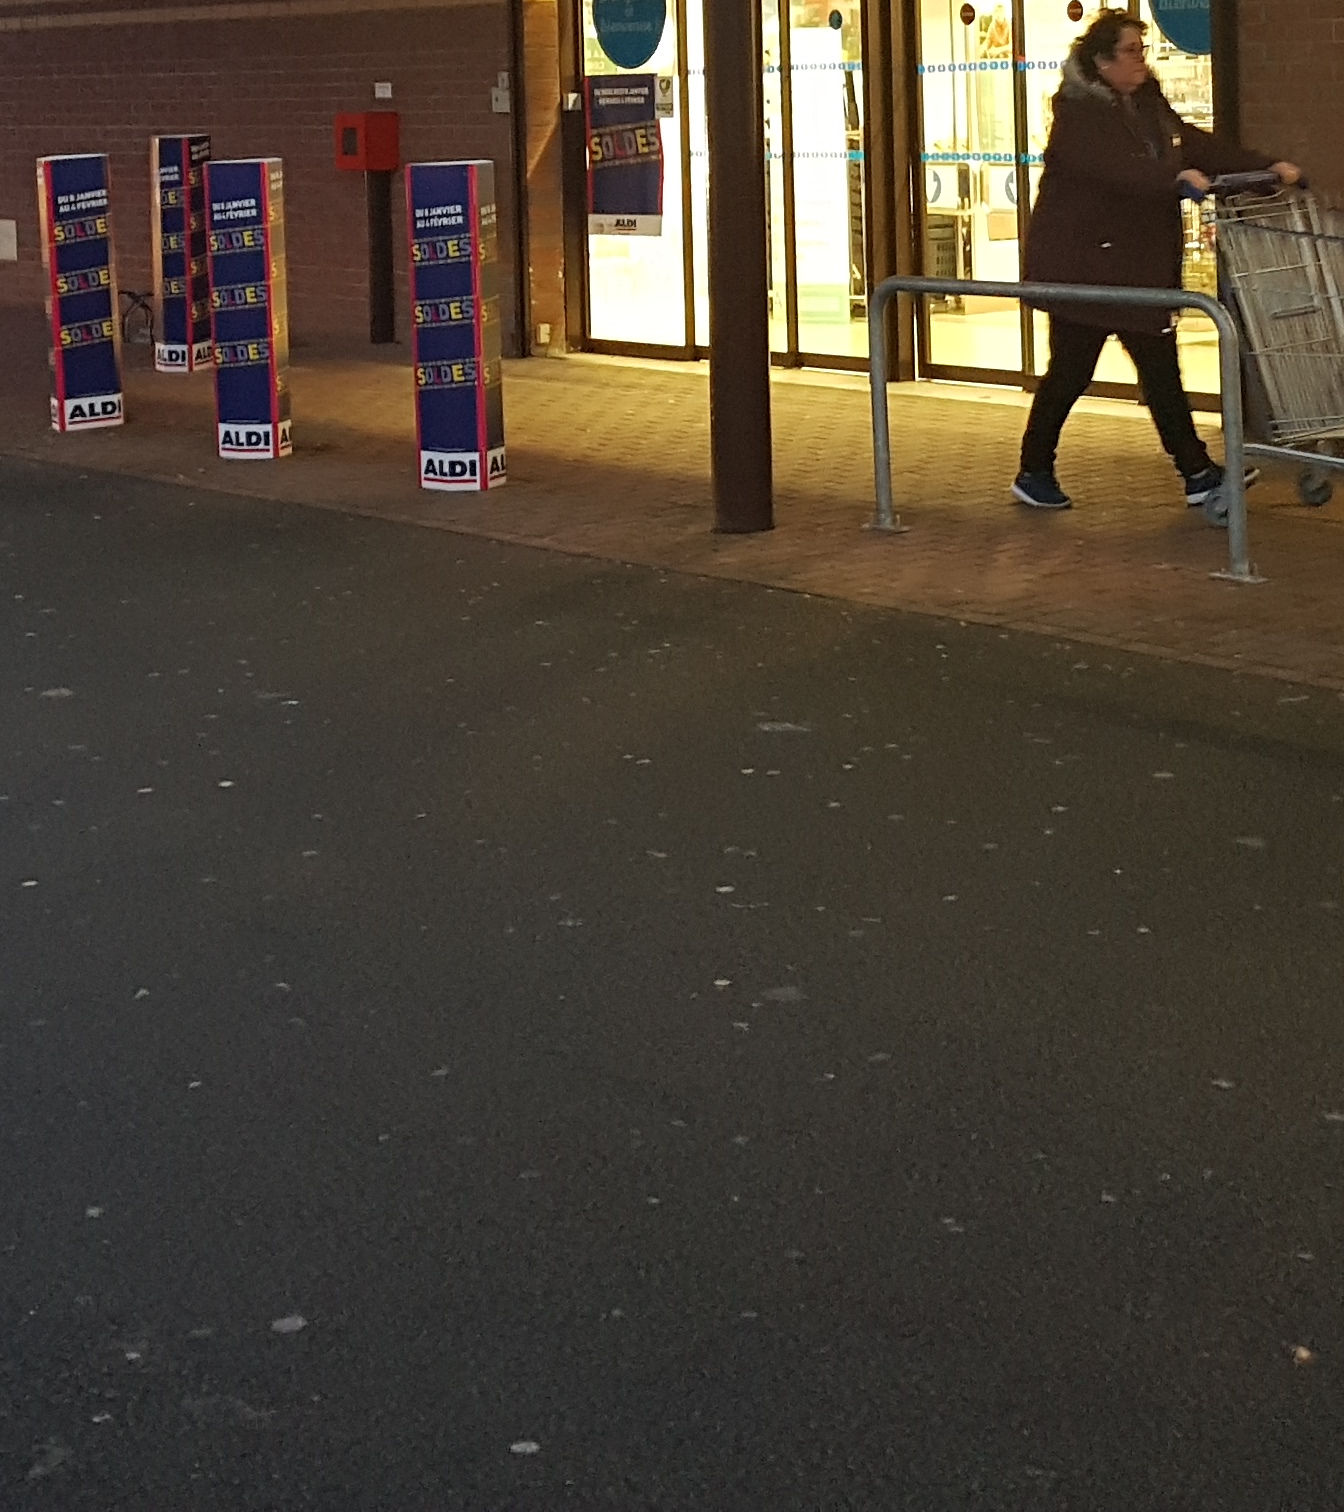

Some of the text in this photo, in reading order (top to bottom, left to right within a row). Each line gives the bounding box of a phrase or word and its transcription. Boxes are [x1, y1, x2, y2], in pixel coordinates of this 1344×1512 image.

[590, 126, 660, 161] SOLDES
[209, 229, 264, 251] SOLDES
[412, 238, 471, 261] SOLDES
[211, 286, 267, 308] SOLDES
[414, 301, 474, 323] SOLDES
[214, 342, 269, 364] SOLDES
[417, 362, 476, 385] SOLDES
[222, 430, 270, 447] ALDI
[424, 458, 477, 477] ALDI
